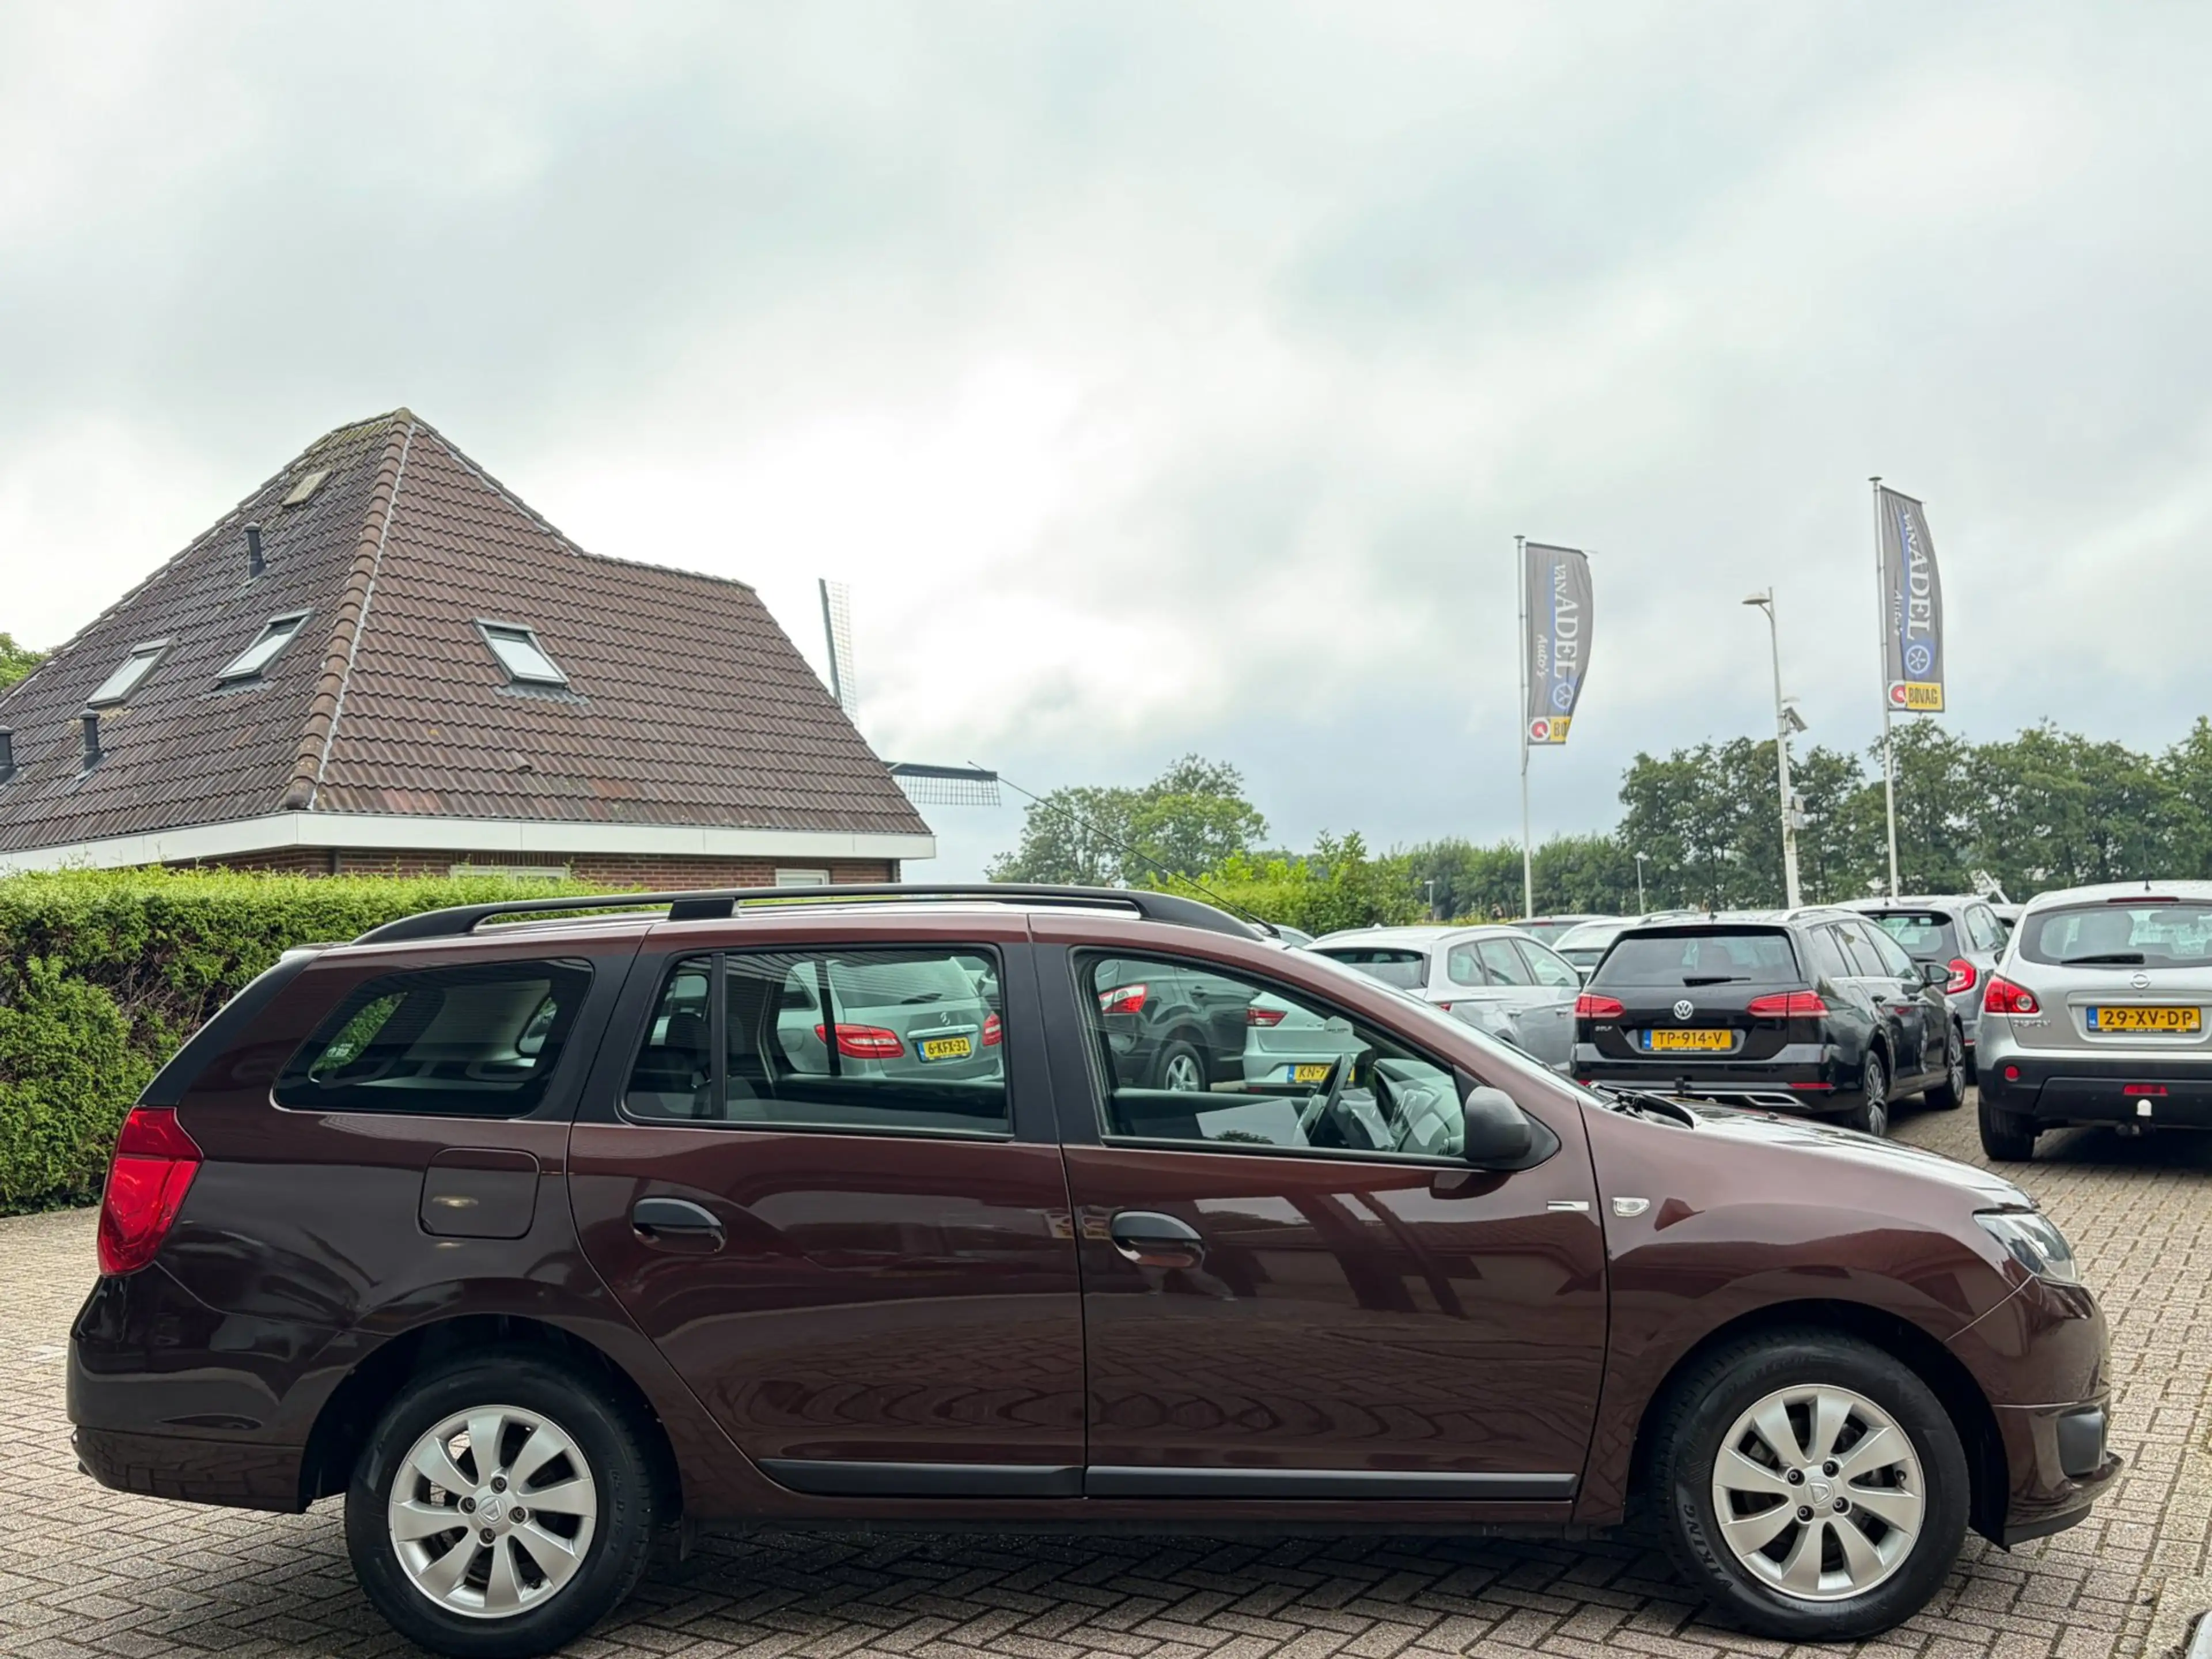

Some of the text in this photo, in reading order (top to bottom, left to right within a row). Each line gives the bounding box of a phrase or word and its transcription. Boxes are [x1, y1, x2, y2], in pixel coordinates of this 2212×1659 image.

[1907, 546, 1931, 640] ADEL
[1554, 565, 1579, 679] VAN ADEL
[1537, 634, 1548, 681] Auto's
[1908, 687, 1938, 704] BOVAG
[2104, 1010, 2194, 1026] 29-XV-DP
[928, 1040, 968, 1055] 6-KFX-32
[1657, 1032, 1722, 1046] TP-914-V
